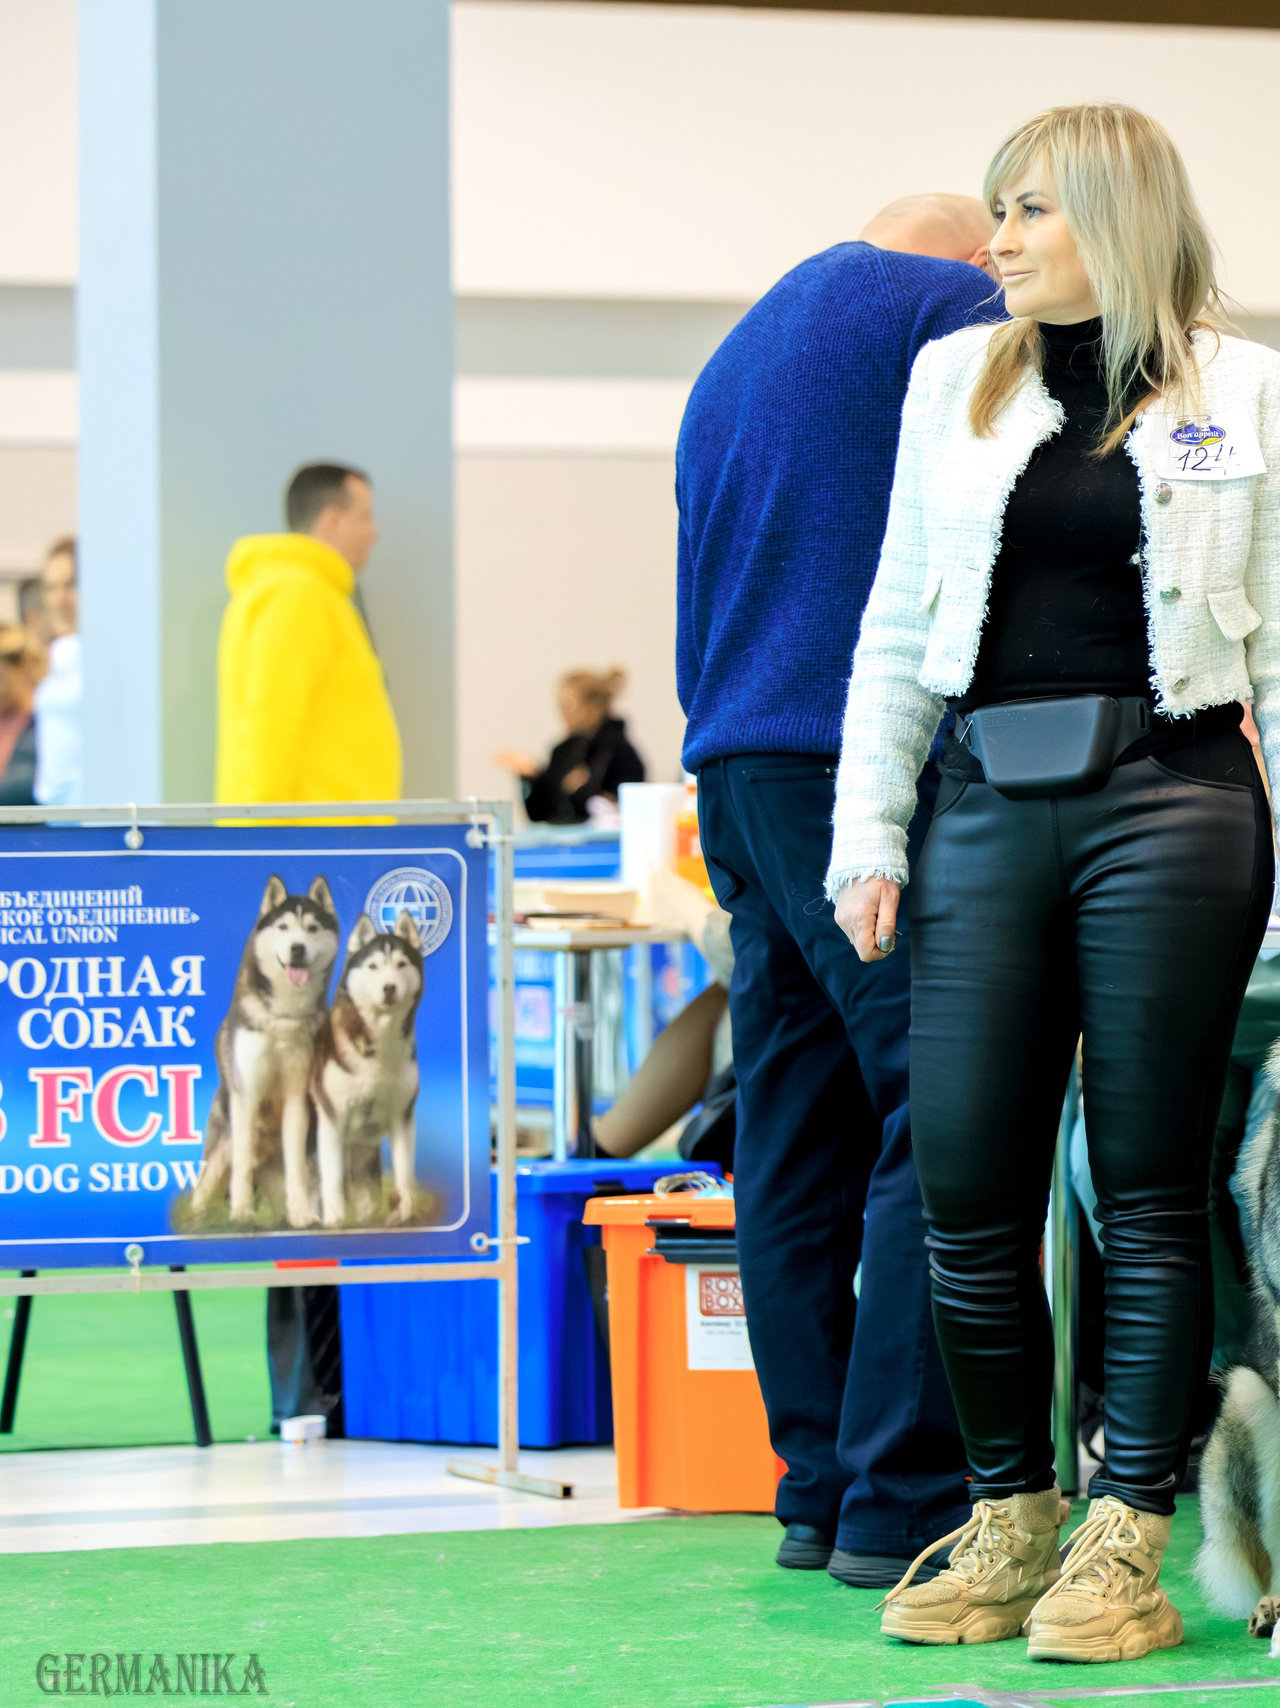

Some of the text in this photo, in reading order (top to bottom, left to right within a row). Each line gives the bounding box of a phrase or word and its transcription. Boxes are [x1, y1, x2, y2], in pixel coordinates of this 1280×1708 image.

[0, 908, 45, 926] КОЕ
[52, 926, 119, 944] UNION
[0, 955, 206, 1007] ОДНАЯ
[17, 1005, 197, 1050] СОБАК
[28, 1064, 203, 1149] FCI
[0, 1160, 208, 1194] DOG SHOW
